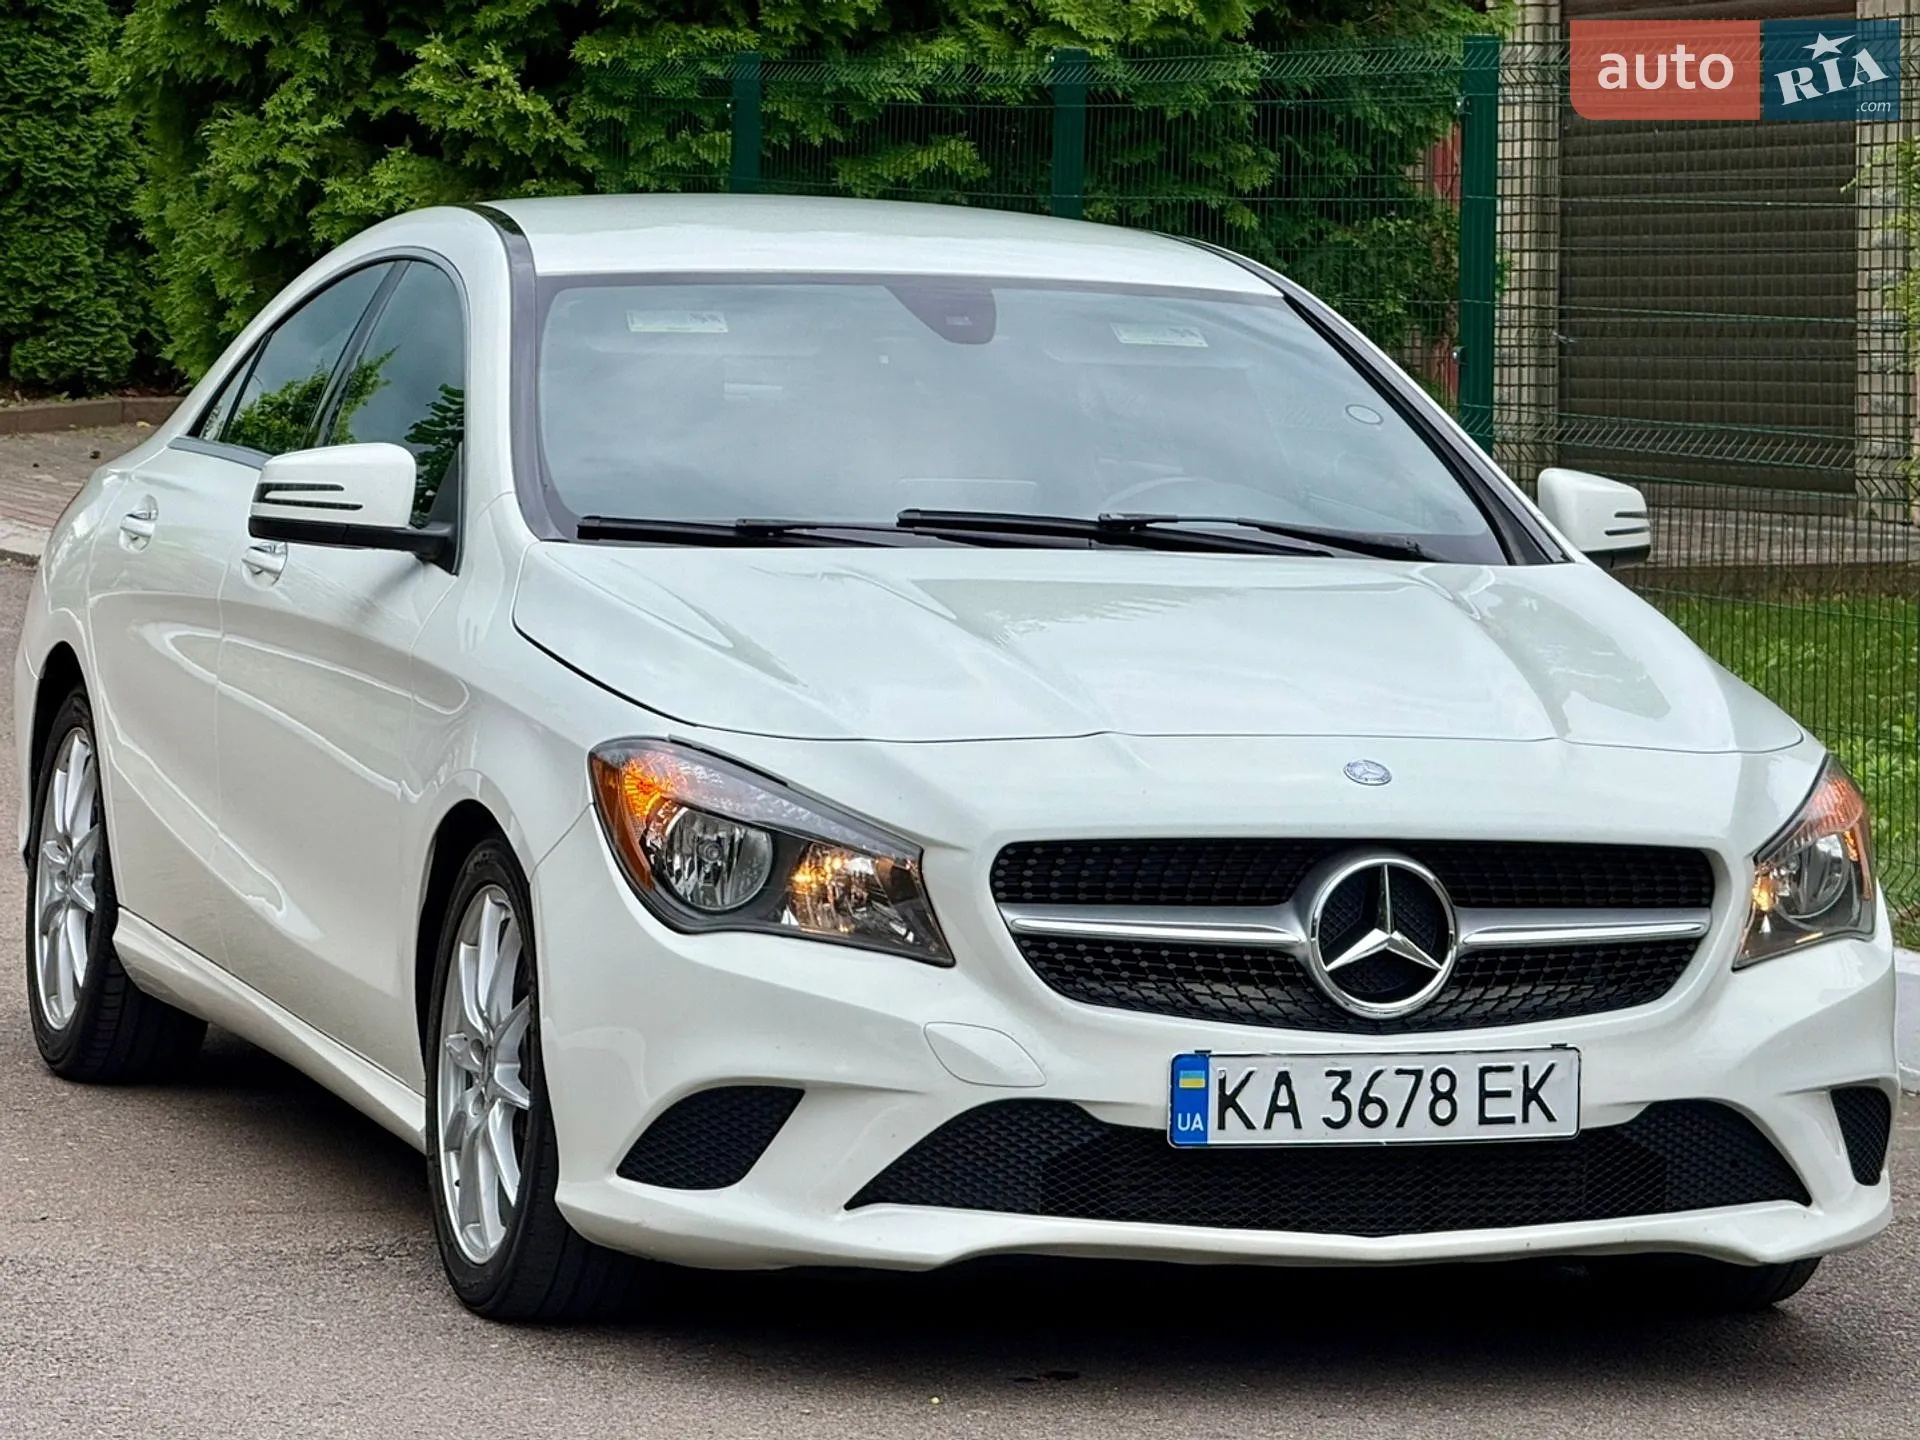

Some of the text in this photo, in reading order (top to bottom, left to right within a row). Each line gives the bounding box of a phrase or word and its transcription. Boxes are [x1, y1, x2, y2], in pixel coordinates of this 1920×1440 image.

[1217, 1062, 1558, 1130] KA 3678 EK
[1177, 1112, 1205, 1132] UA
